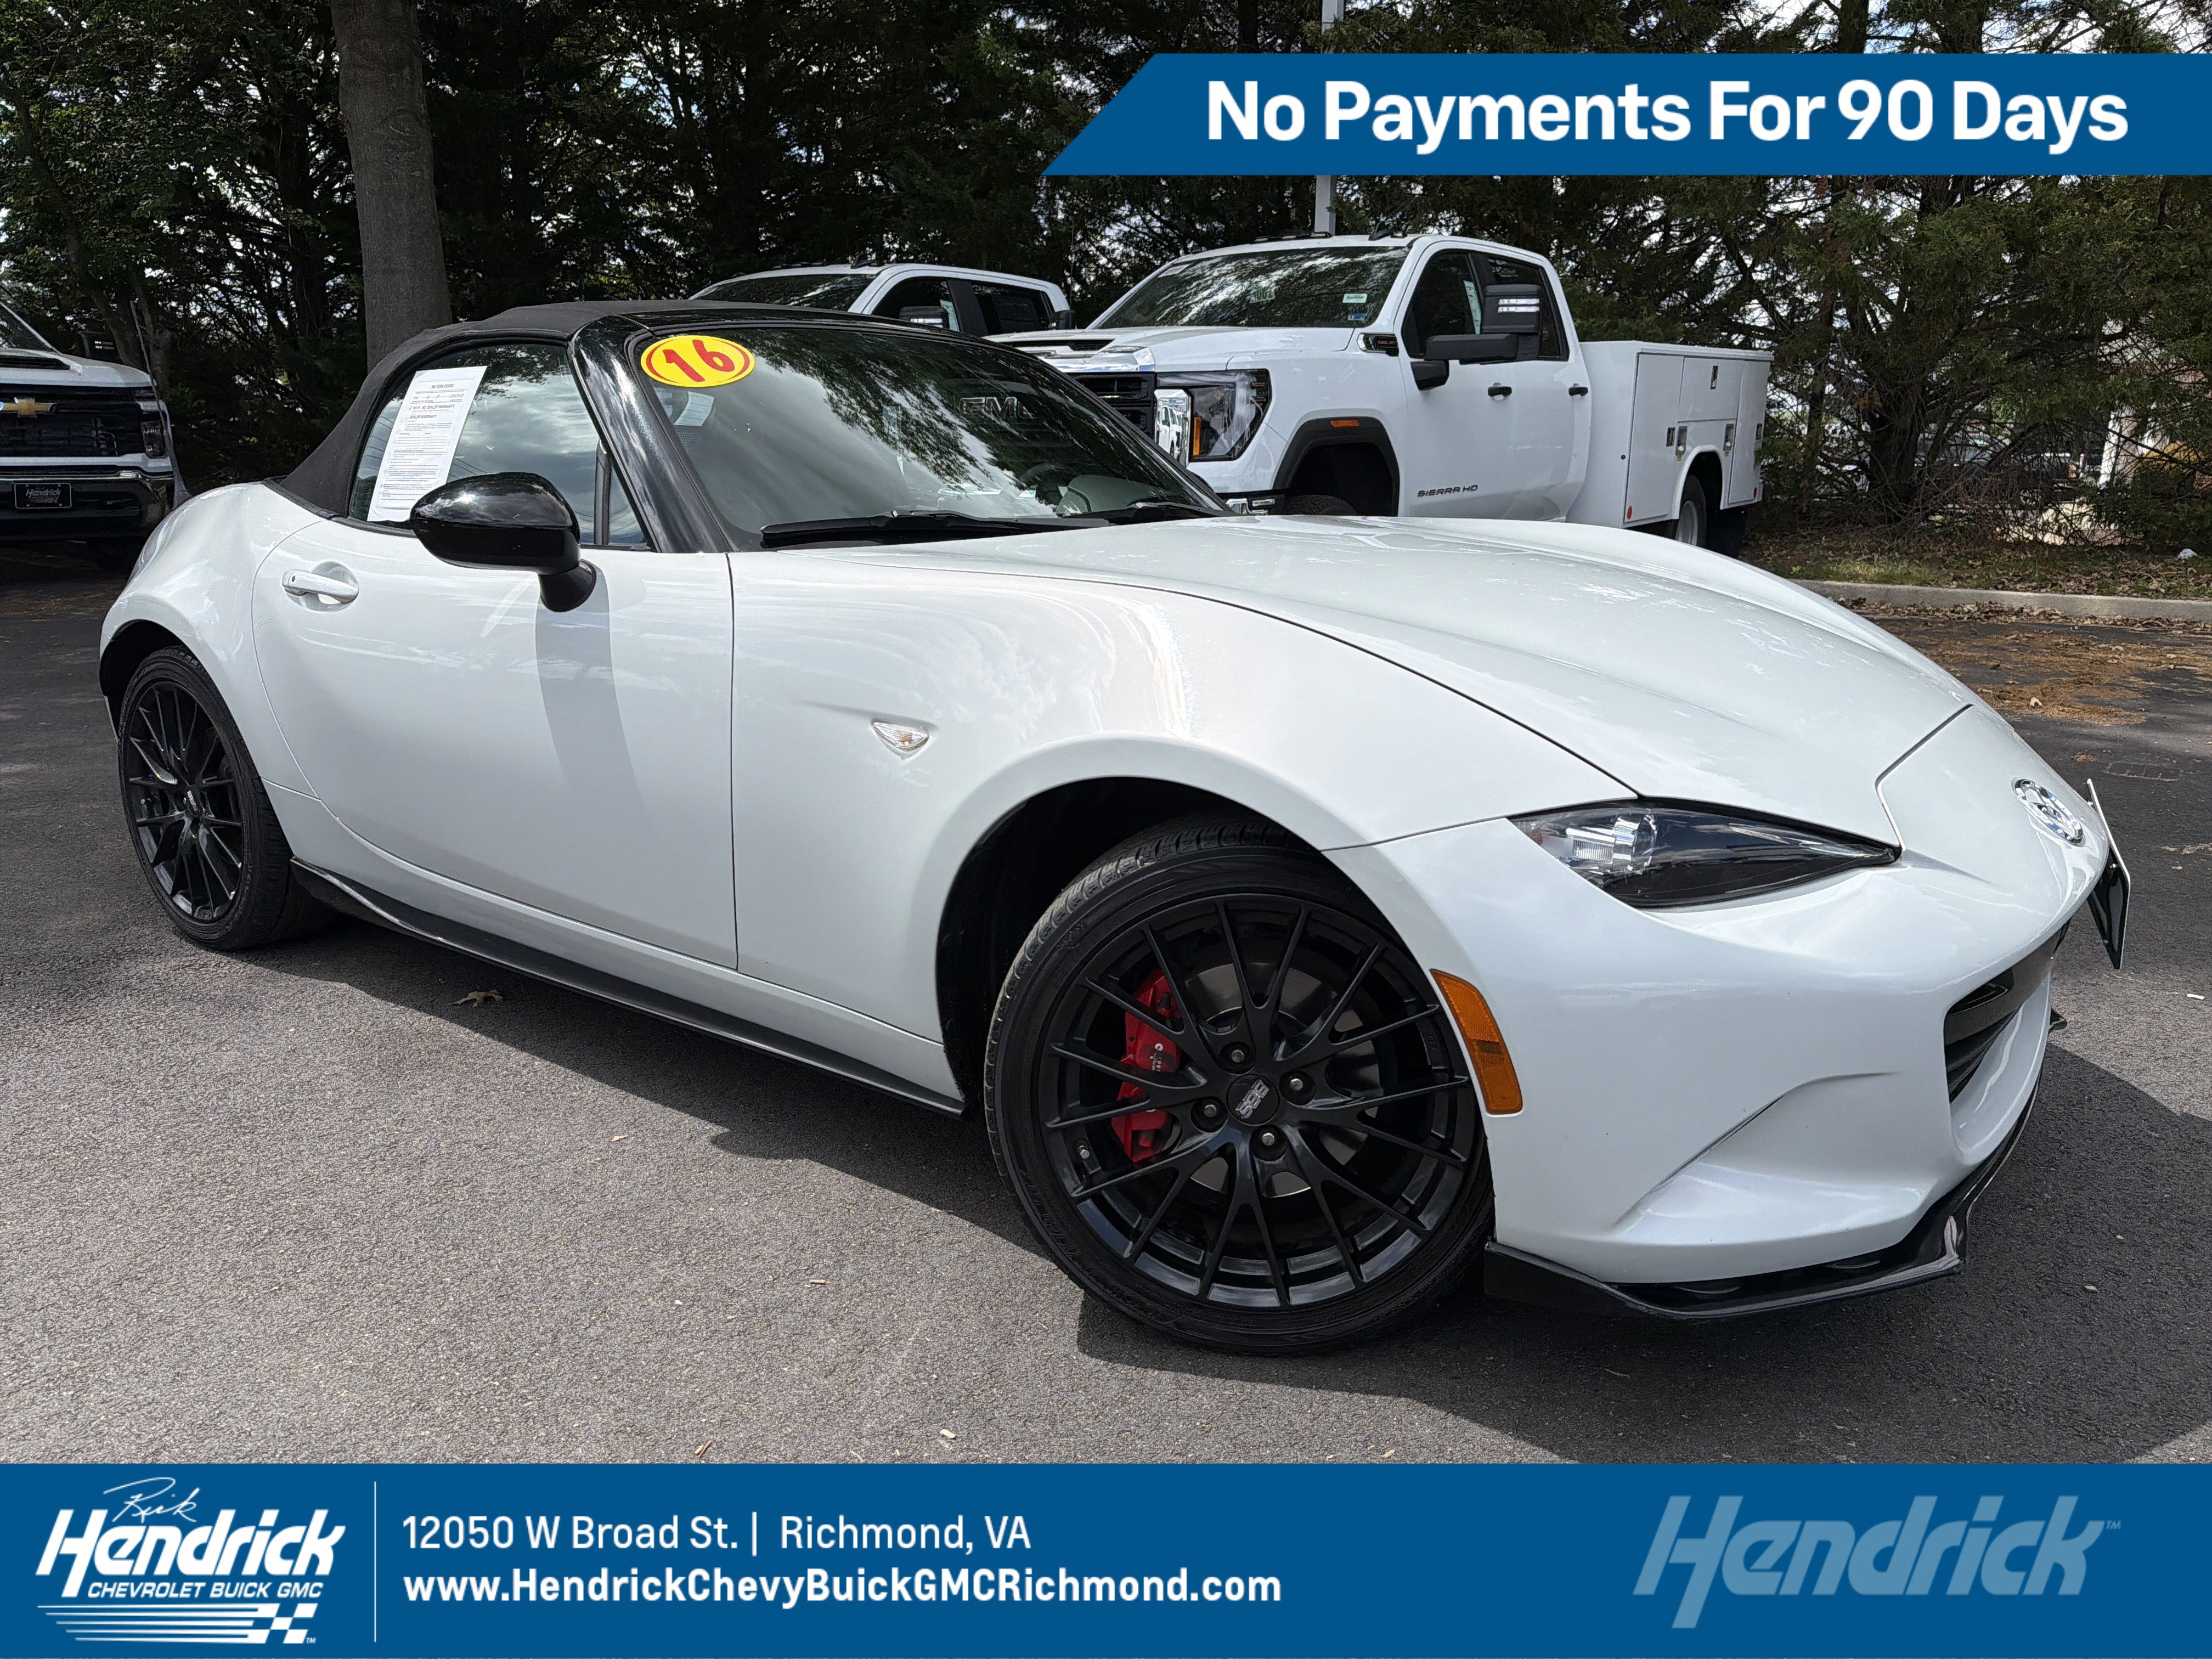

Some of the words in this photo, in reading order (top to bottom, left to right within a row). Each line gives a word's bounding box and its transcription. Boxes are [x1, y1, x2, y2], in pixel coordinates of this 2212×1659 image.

[662, 340, 735, 382] 16
[1417, 487, 1460, 497] SIERRA
[1235, 1079, 1269, 1119] BBS
